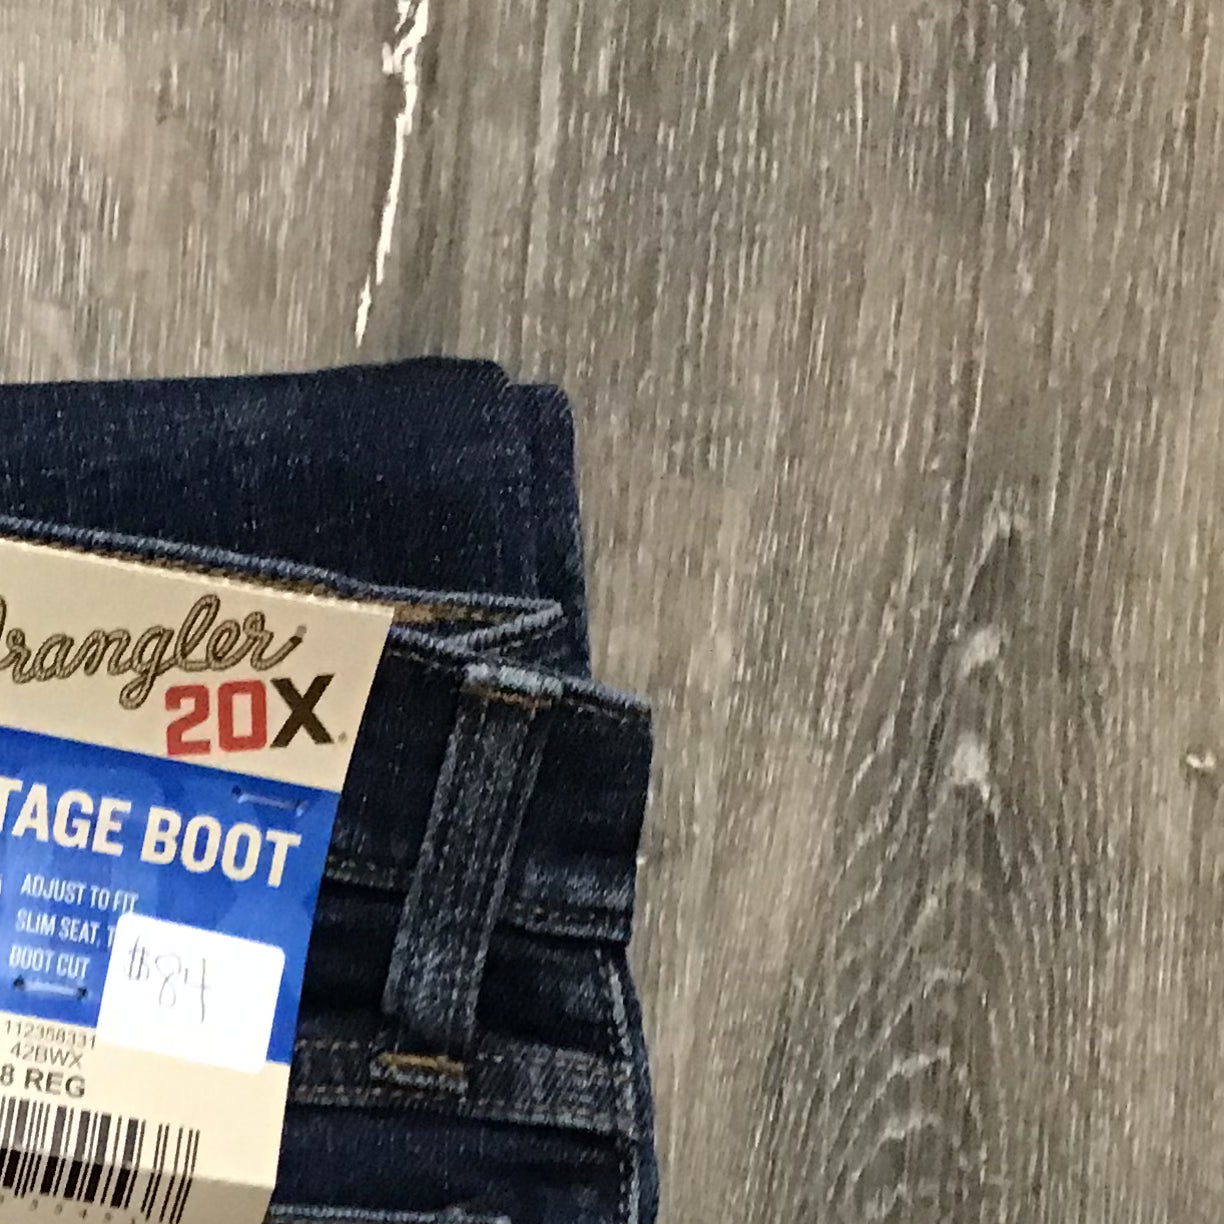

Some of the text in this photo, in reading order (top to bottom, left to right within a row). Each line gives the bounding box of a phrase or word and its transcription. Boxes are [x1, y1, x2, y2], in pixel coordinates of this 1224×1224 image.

[165, 674, 336, 757] 20X
[140, 806, 302, 889] BOOT
[20, 872, 140, 914] ADJUST TO FIT
[16, 907, 57, 936] SLIM
[58, 916, 101, 949] SEAT,
[9, 944, 91, 981] BOOT CUT
[0, 1063, 86, 1098] 8 REG
